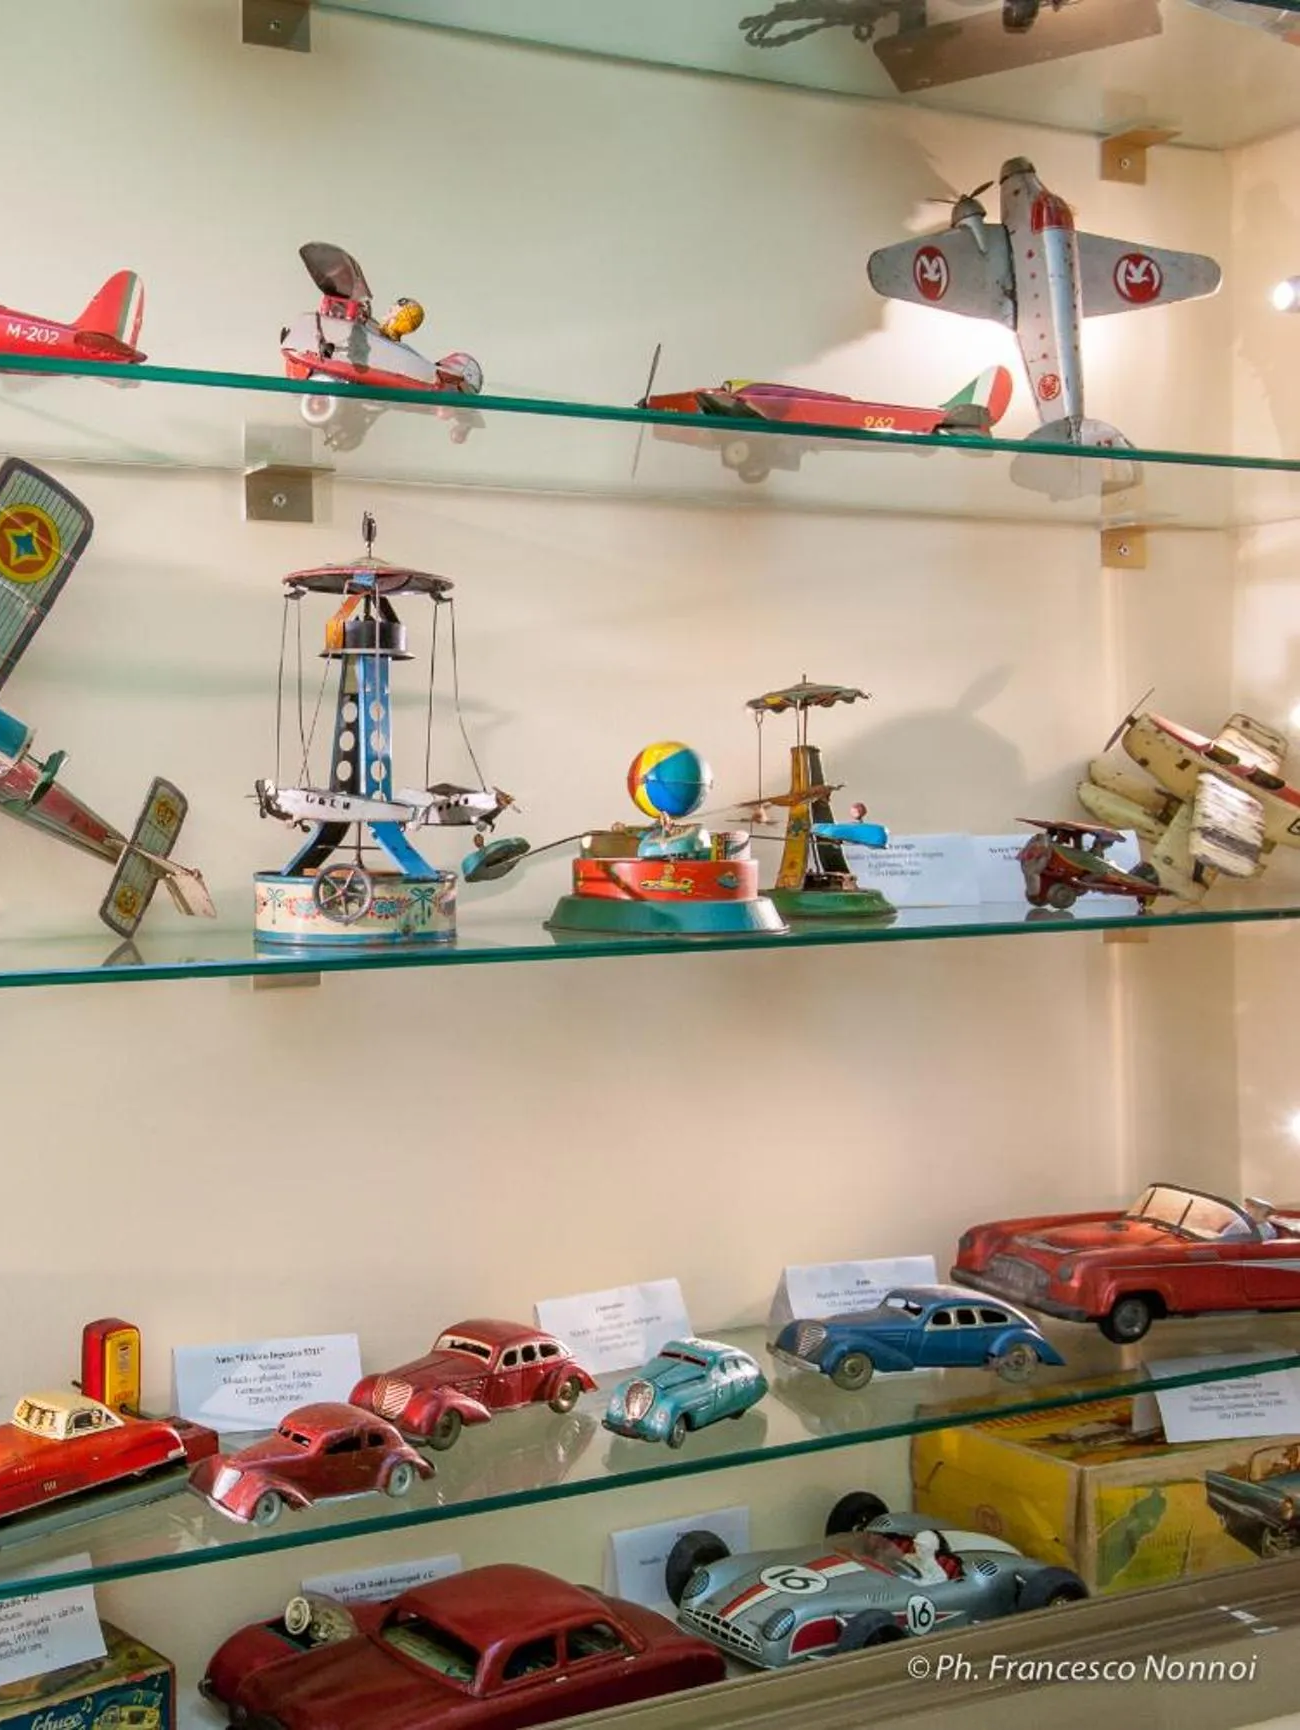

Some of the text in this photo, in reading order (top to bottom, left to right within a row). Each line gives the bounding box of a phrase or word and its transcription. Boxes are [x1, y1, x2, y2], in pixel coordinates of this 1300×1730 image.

[6, 323, 60, 345] M-202
[864, 415, 895, 429] 962
[773, 1567, 812, 1590] 16
[912, 1601, 932, 1627] 16
